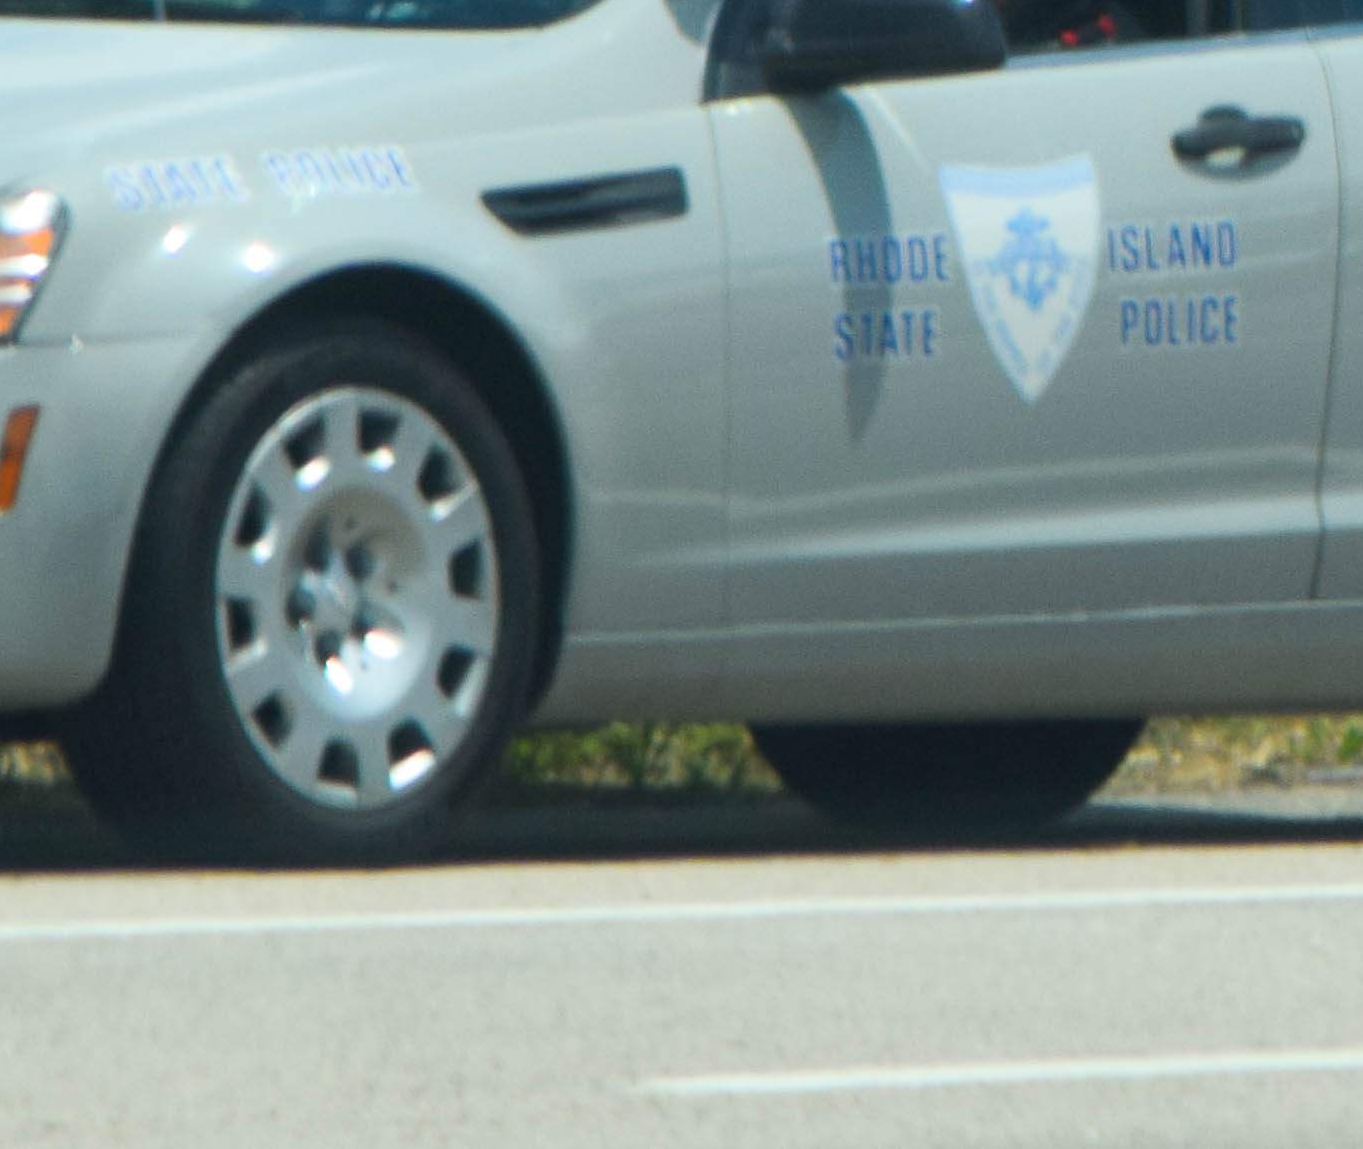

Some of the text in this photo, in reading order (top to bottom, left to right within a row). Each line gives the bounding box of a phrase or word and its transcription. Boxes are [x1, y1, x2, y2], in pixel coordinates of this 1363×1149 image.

[106, 146, 416, 211] STATE POLICE
[828, 220, 1238, 284] RHODE ISLAND
[832, 295, 1238, 361] STATE POLICE
